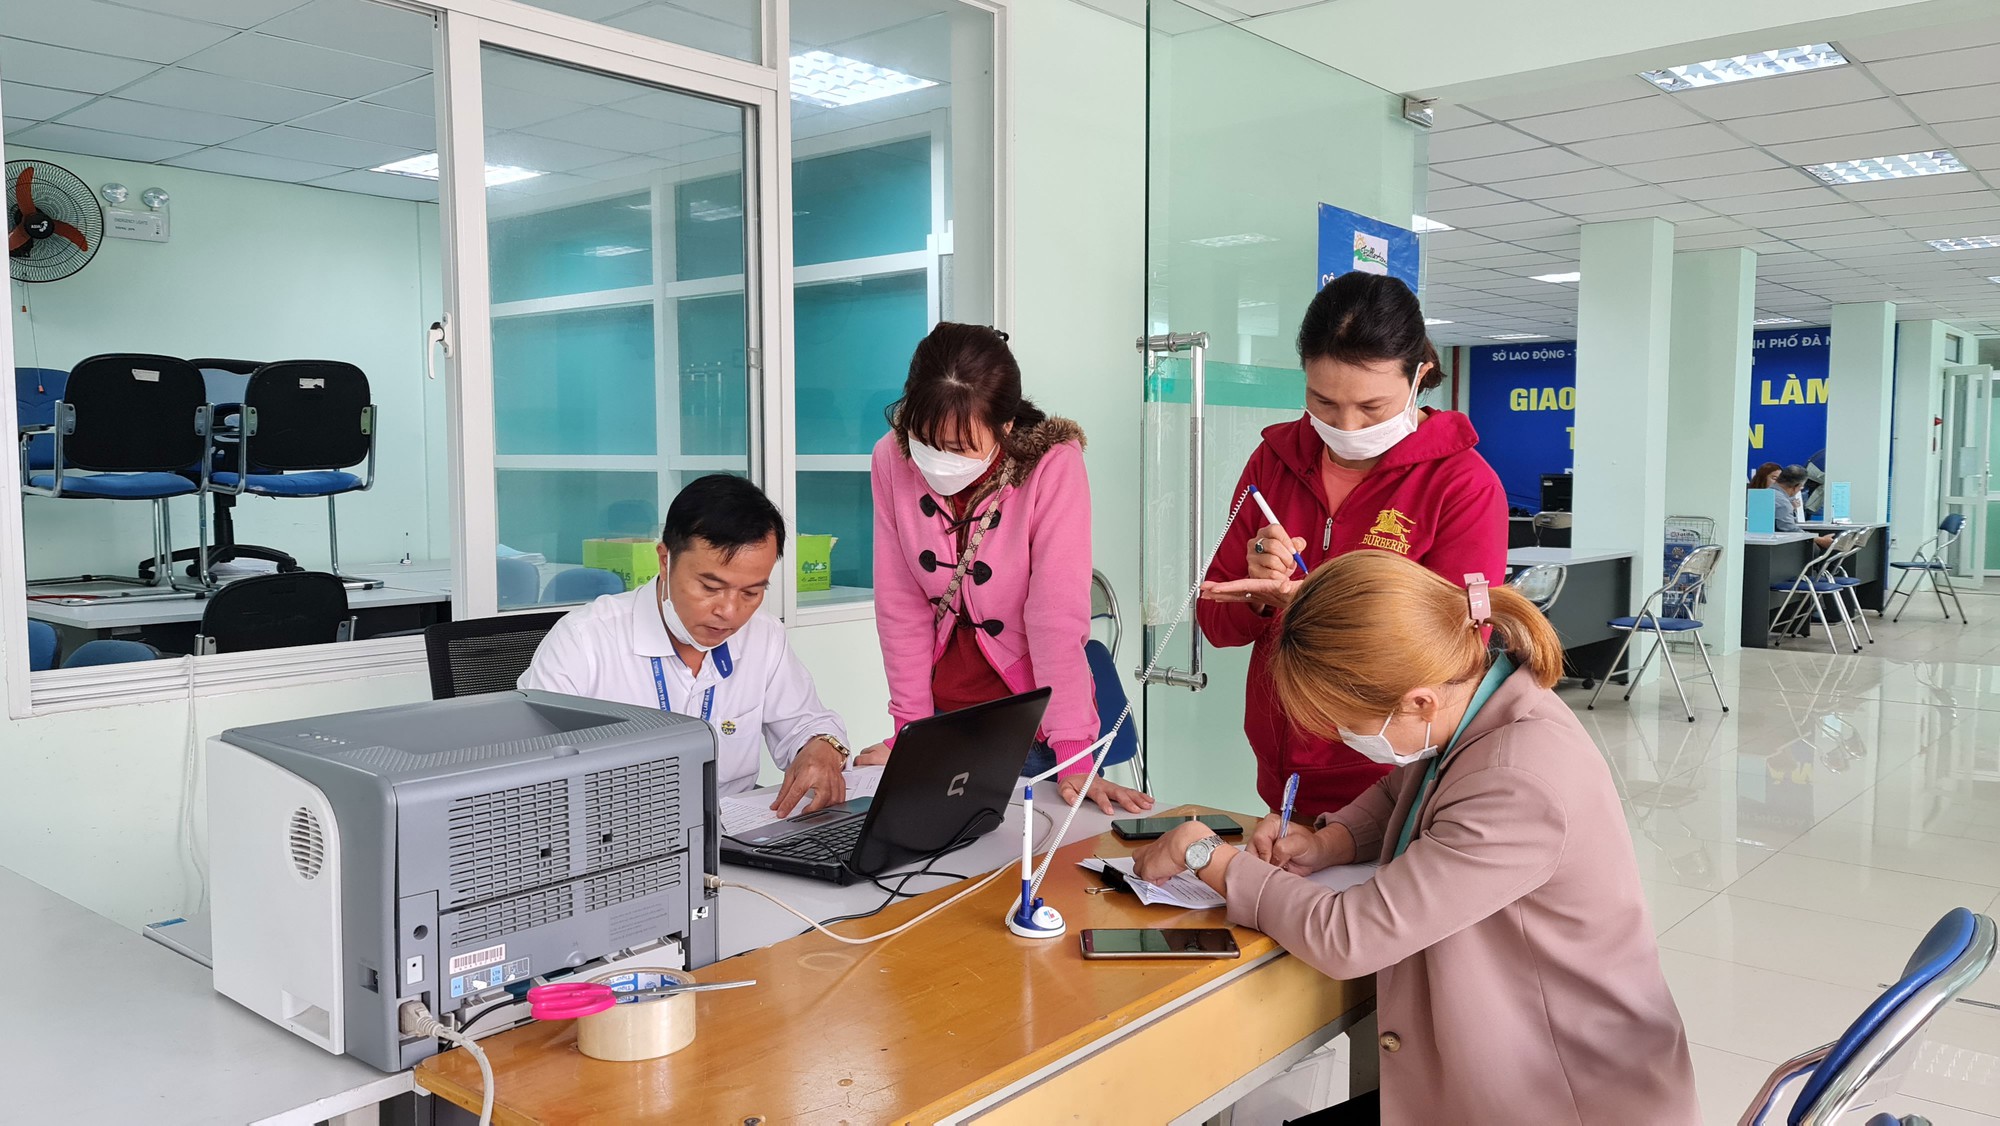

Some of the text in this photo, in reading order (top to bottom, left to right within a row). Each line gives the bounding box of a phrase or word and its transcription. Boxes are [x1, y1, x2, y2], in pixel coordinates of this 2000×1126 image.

[1769, 333, 1799, 348] PHỐ
[1802, 333, 1822, 347] ĐÀ
[1509, 351, 1530, 360] LAO
[1532, 348, 1566, 361] ĐỘNG
[1510, 386, 1576, 412] GIAO
[1761, 373, 1829, 406] LÀM
[1362, 534, 1412, 555] BURBERRY
